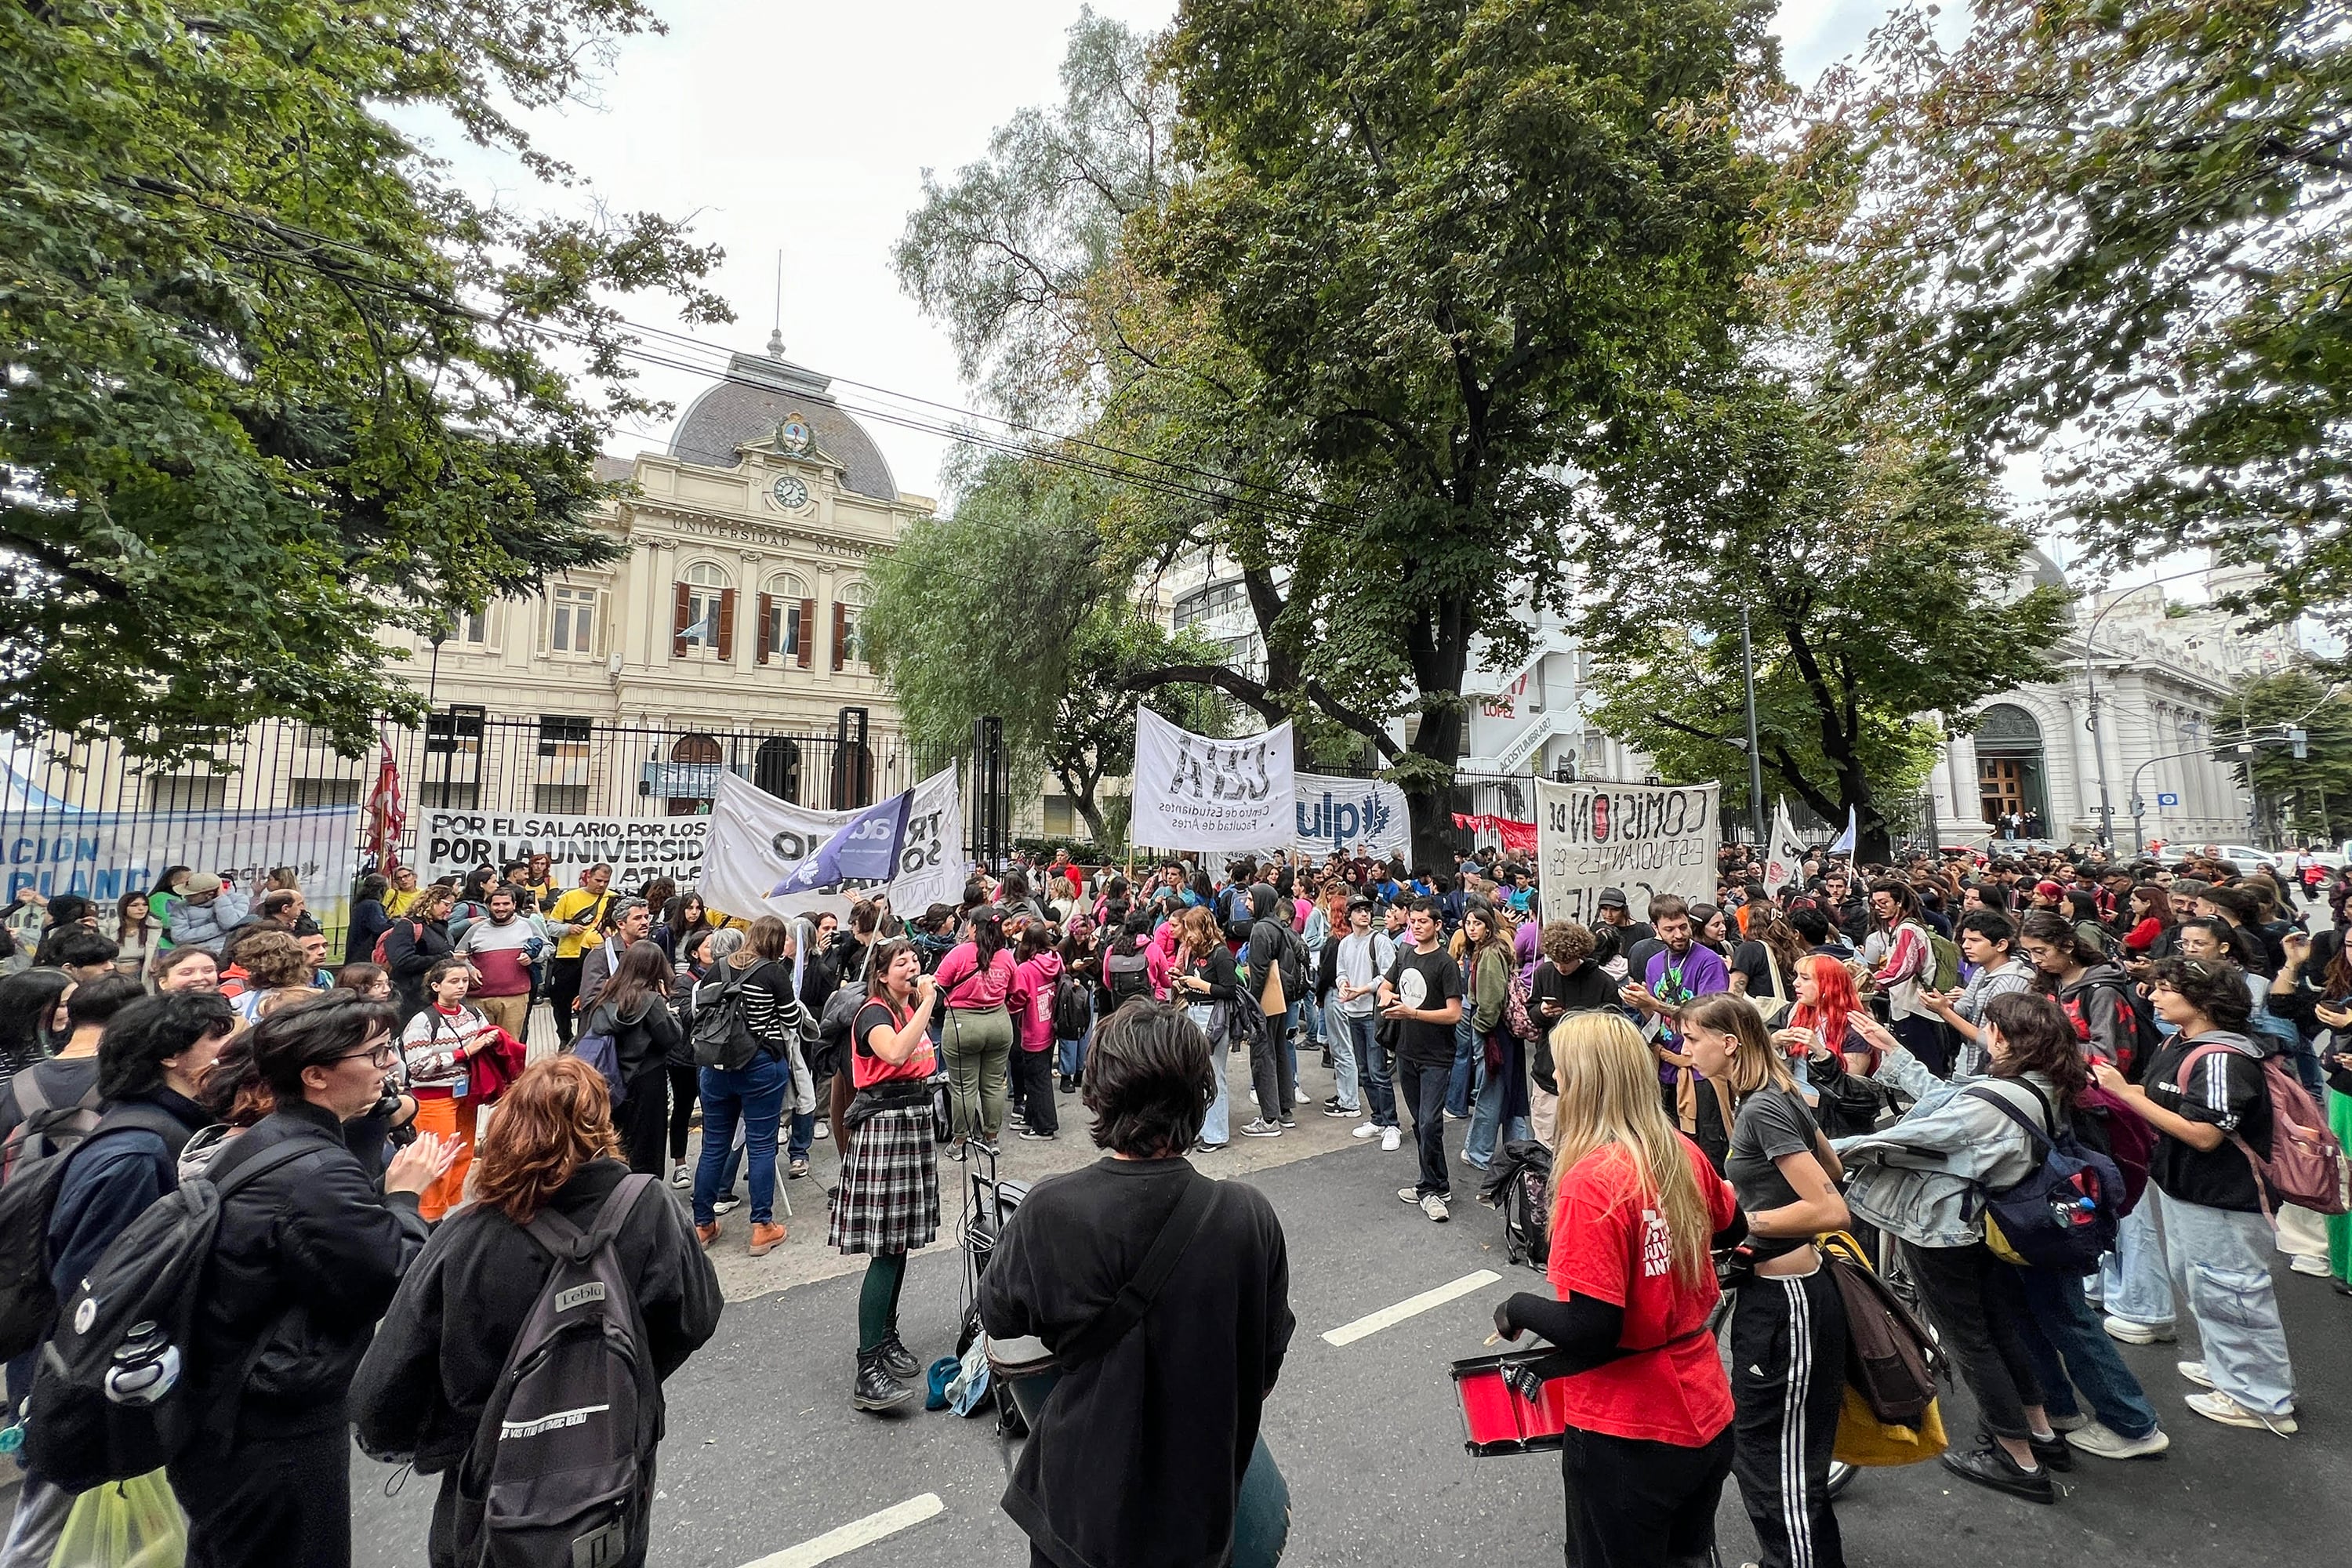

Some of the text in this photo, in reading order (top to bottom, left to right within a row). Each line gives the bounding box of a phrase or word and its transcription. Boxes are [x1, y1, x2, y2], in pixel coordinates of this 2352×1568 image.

[673, 519, 790, 547] UNIVERSIDAD
[1500, 717, 1551, 773] ACOSTUMBRAR?
[432, 815, 707, 840] POR EL SALARIO, POR LOS
[430, 838, 704, 865] POR LA UNIVERSID
[563, 1287, 601, 1305] Leblu
